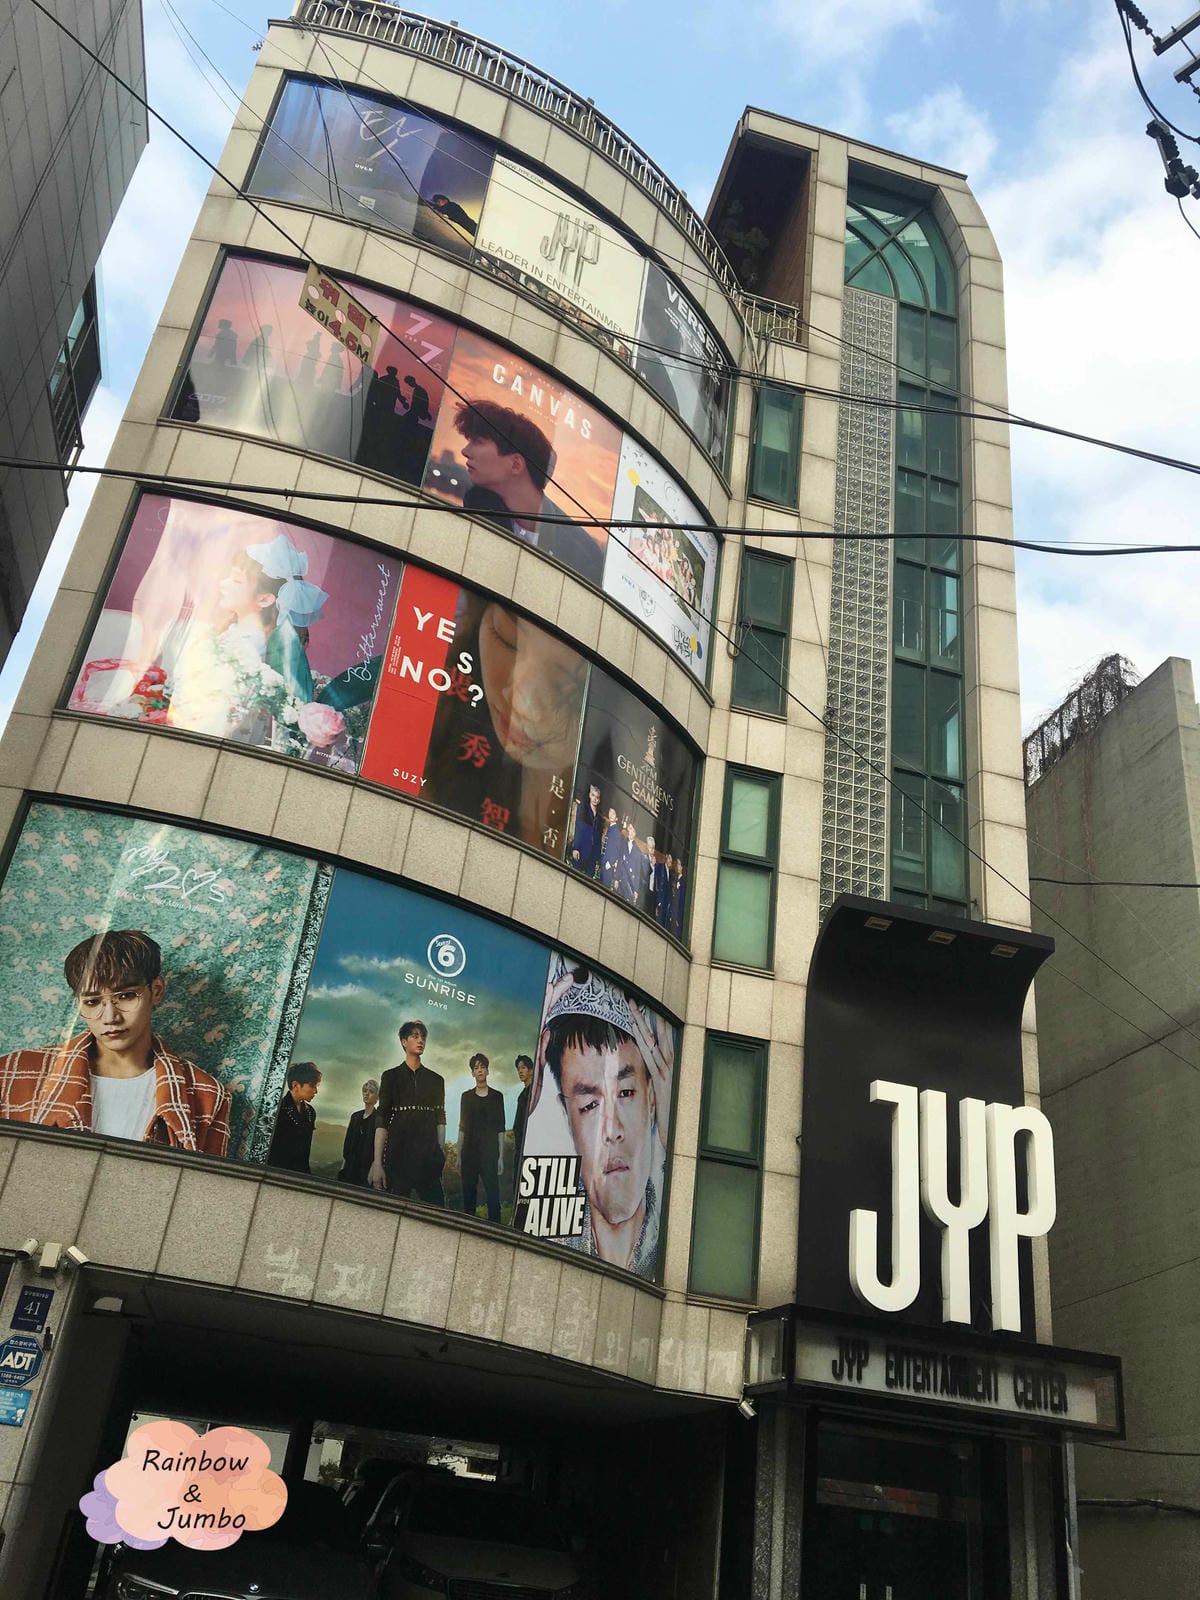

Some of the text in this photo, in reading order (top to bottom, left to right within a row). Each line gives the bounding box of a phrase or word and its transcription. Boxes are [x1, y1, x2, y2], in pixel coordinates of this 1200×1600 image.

[480, 238, 529, 270] LEADER
[531, 264, 545, 279] IN
[666, 281, 715, 358] VERSE
[492, 363, 592, 439] CANVAS
[392, 767, 428, 788] SUZY
[631, 780, 661, 813] GAME
[437, 944, 456, 968] 6
[404, 972, 477, 1006] SUNRISE
[519, 1157, 577, 1197] STILL
[523, 1196, 586, 1237] ALIVE
[848, 1079, 1057, 1333] JYP
[23, 1301, 41, 1316] 41
[0, 1351, 37, 1371] ADT
[831, 1336, 870, 1384] JYP
